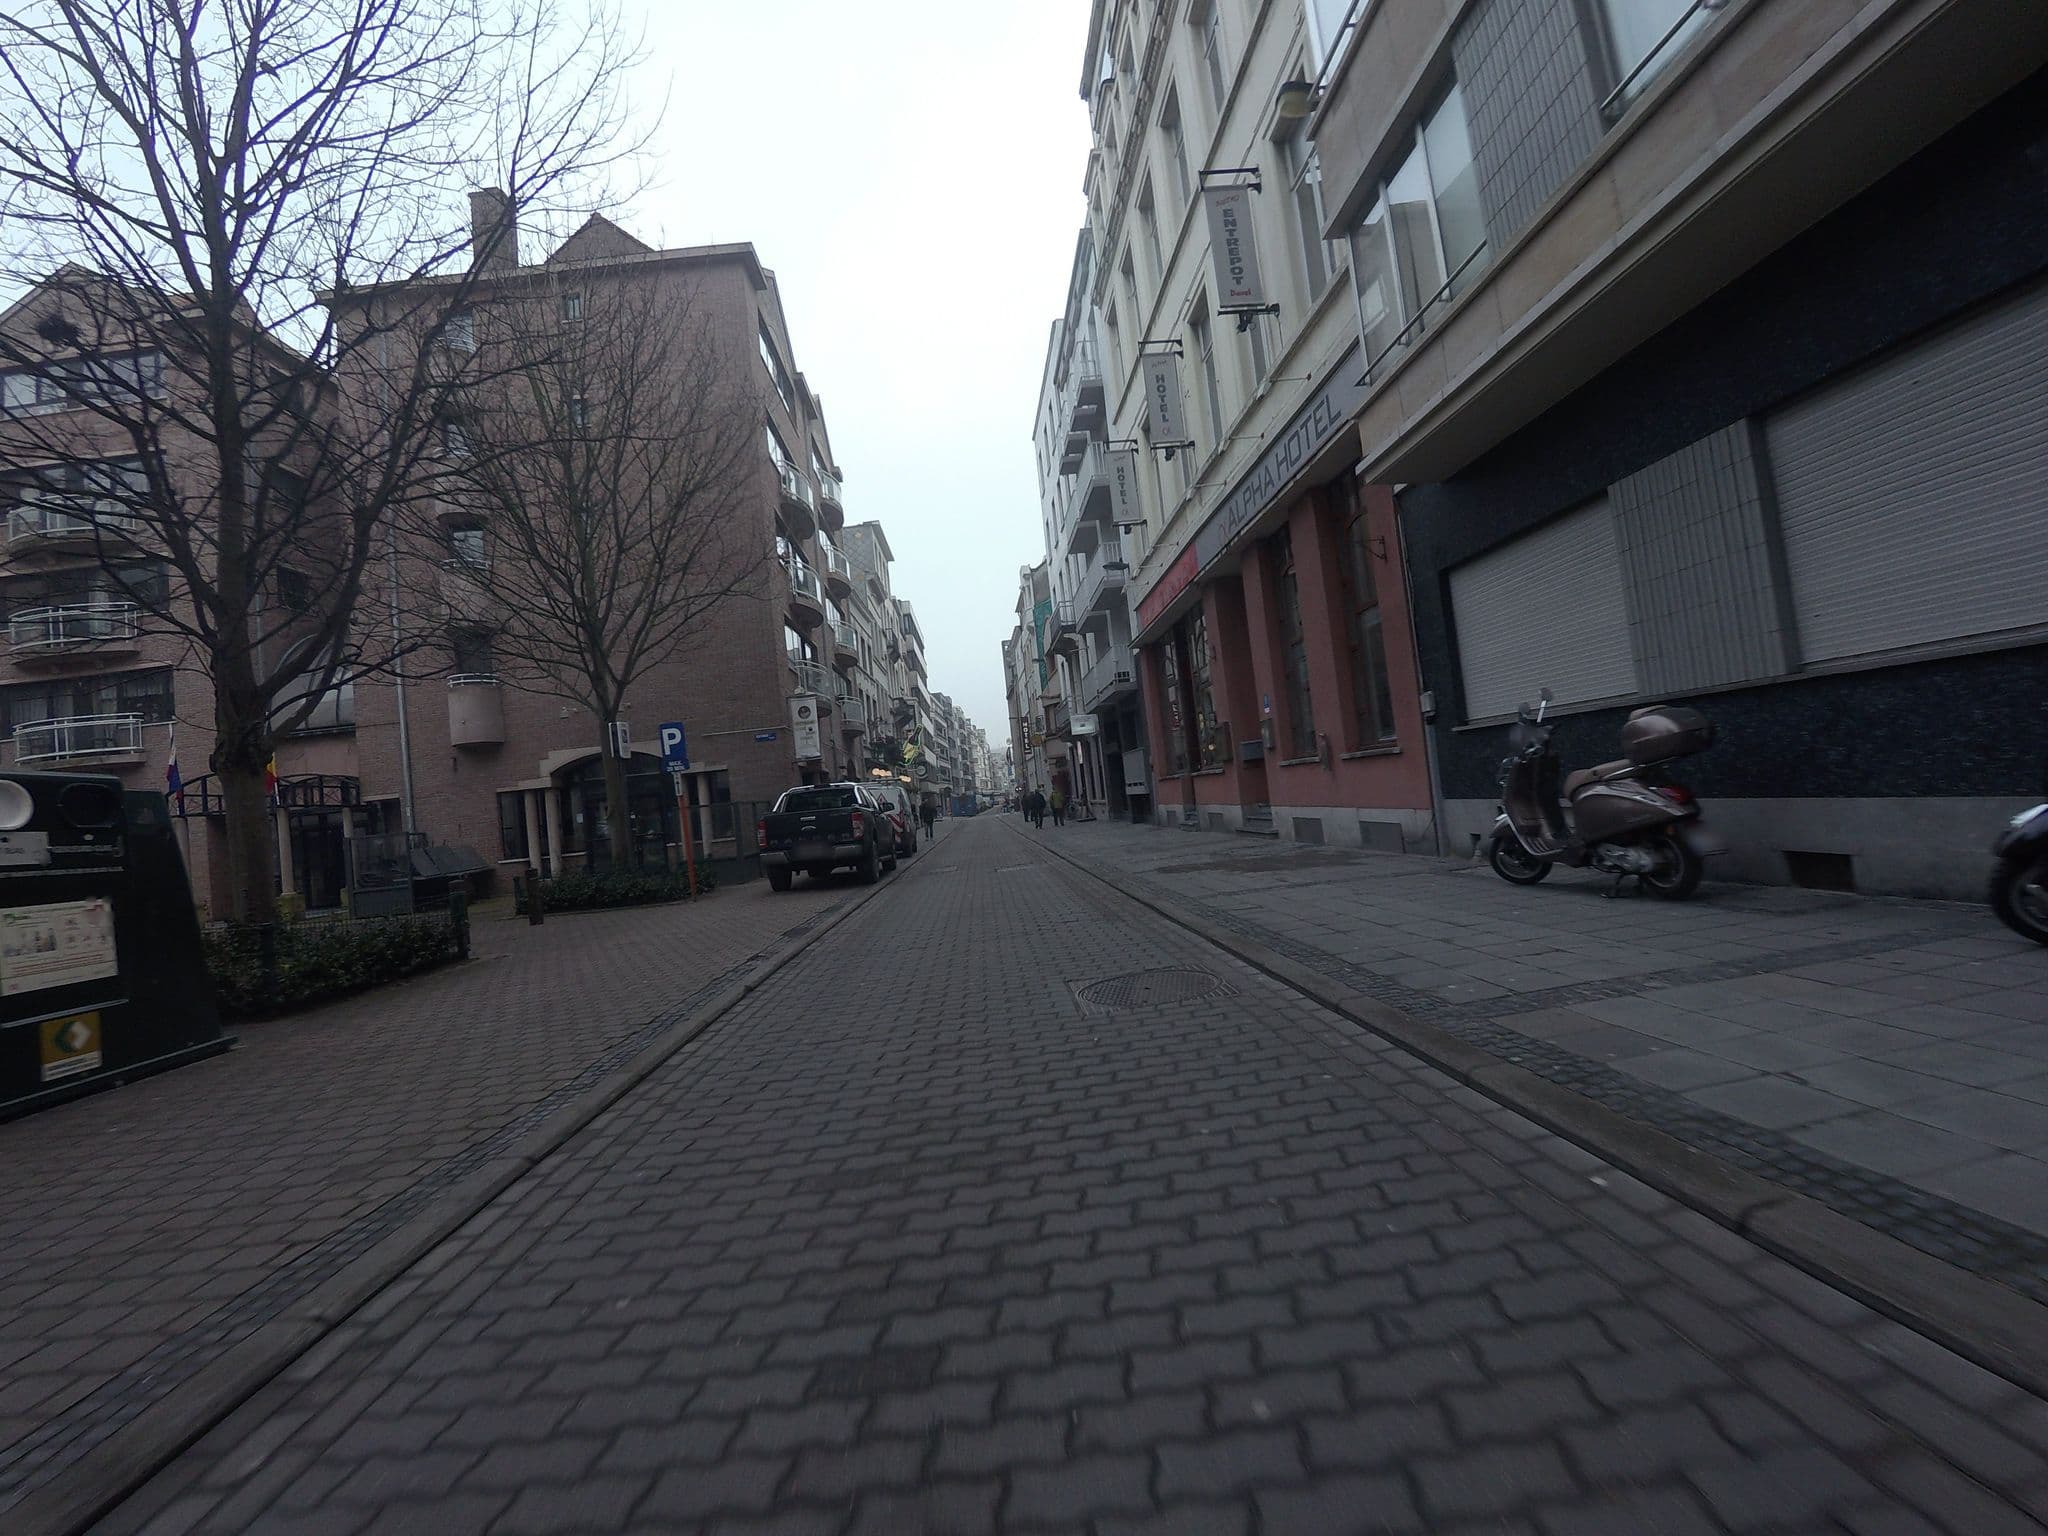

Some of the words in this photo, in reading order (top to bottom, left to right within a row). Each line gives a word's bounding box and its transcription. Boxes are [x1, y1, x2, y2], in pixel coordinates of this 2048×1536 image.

[1222, 208, 1244, 286] ENTREPOT
[1155, 374, 1169, 423] HOTEL
[1116, 466, 1128, 505] HOTEL
[1228, 465, 1275, 530] ALPHA
[1275, 394, 1342, 480] HOTEL
[662, 728, 682, 755] P
